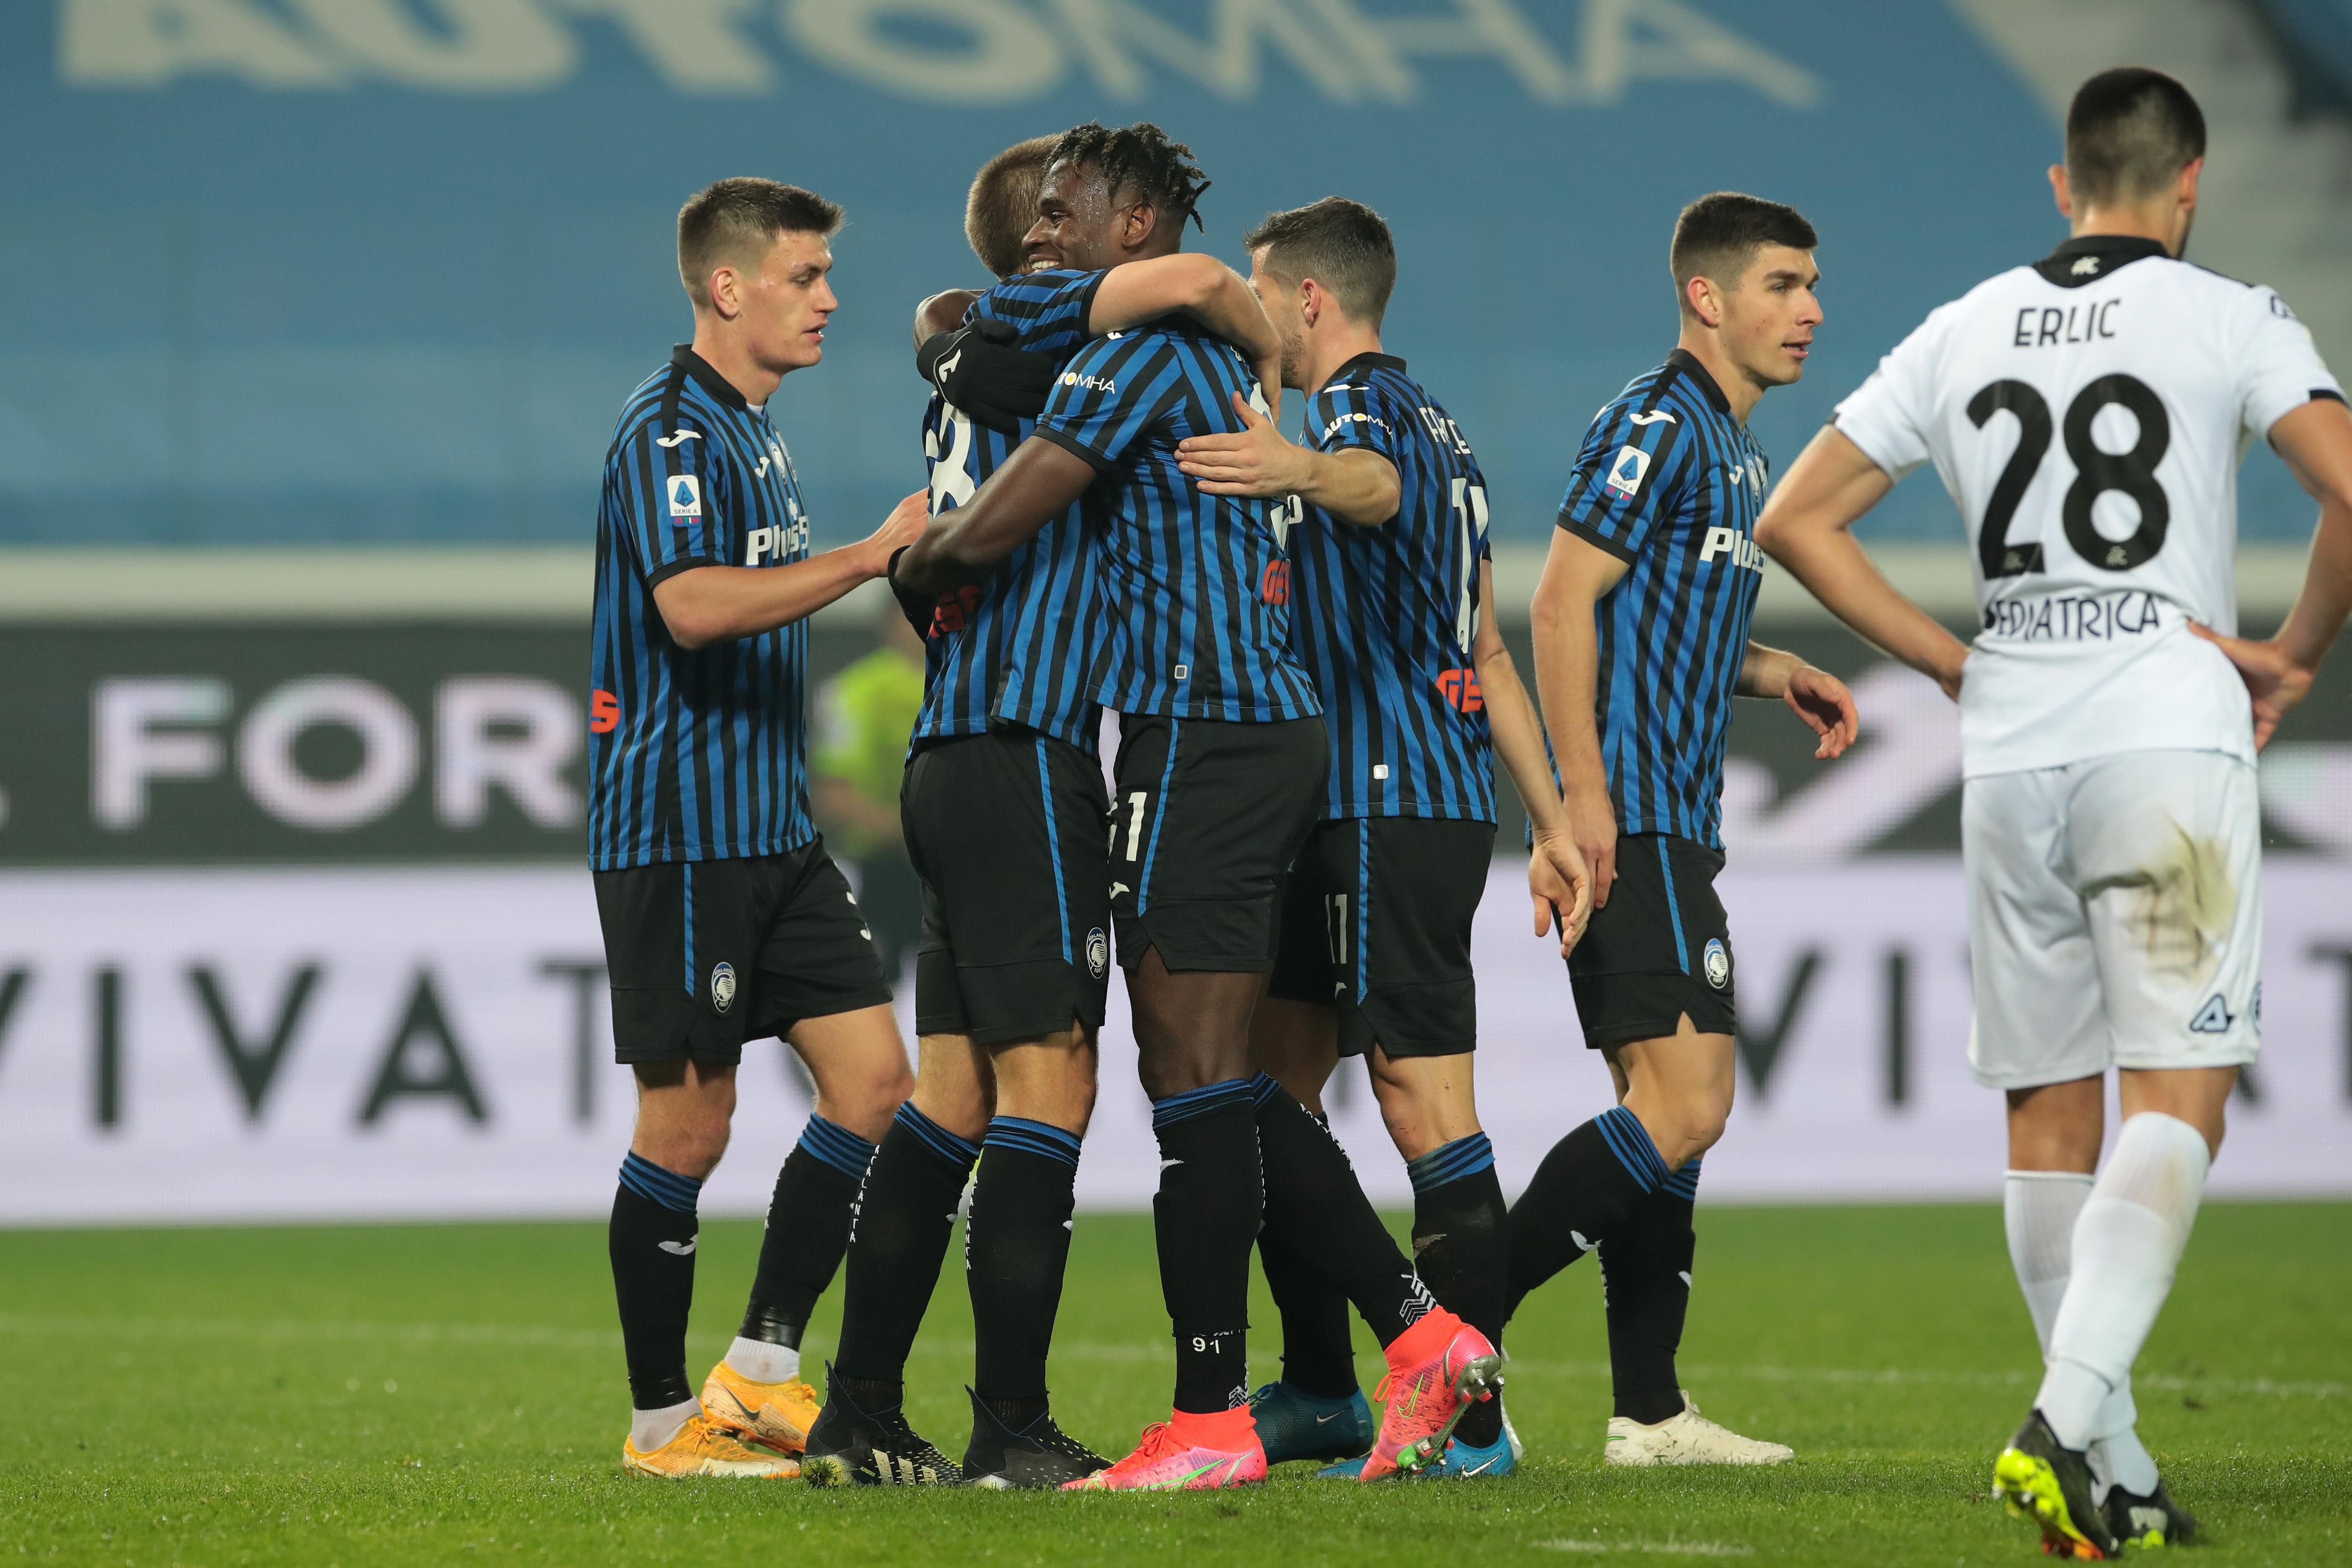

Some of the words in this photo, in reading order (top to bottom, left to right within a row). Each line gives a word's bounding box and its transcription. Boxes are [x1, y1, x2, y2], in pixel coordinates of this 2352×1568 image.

[2014, 299, 2121, 347] ERLIC
[1054, 372, 1116, 395] TOMHA
[1611, 478, 1628, 490] SERIE
[1965, 373, 2170, 580] 28
[1192, 1337, 1220, 1354] 91
